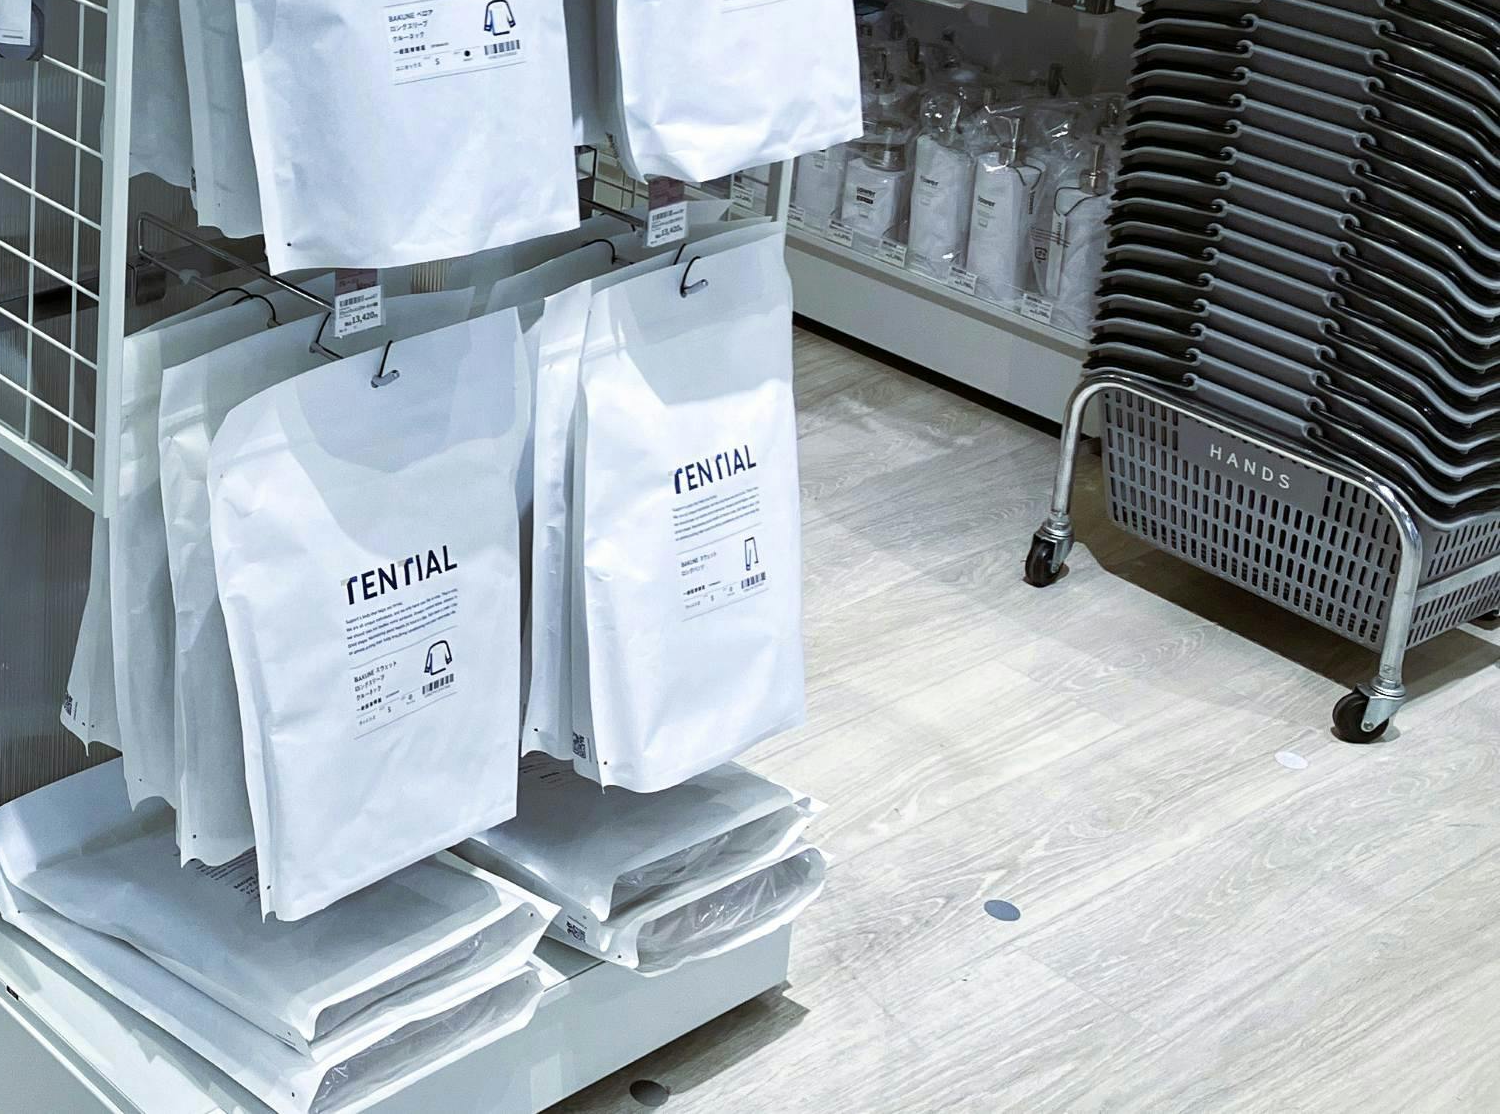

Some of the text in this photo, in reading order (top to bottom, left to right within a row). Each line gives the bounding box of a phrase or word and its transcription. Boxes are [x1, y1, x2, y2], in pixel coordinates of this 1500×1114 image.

[416, 9, 434, 17] ベロア
[669, 444, 757, 494] TENTIAL
[1209, 444, 1290, 489] HANDS
[340, 545, 458, 605] TENTIAL
